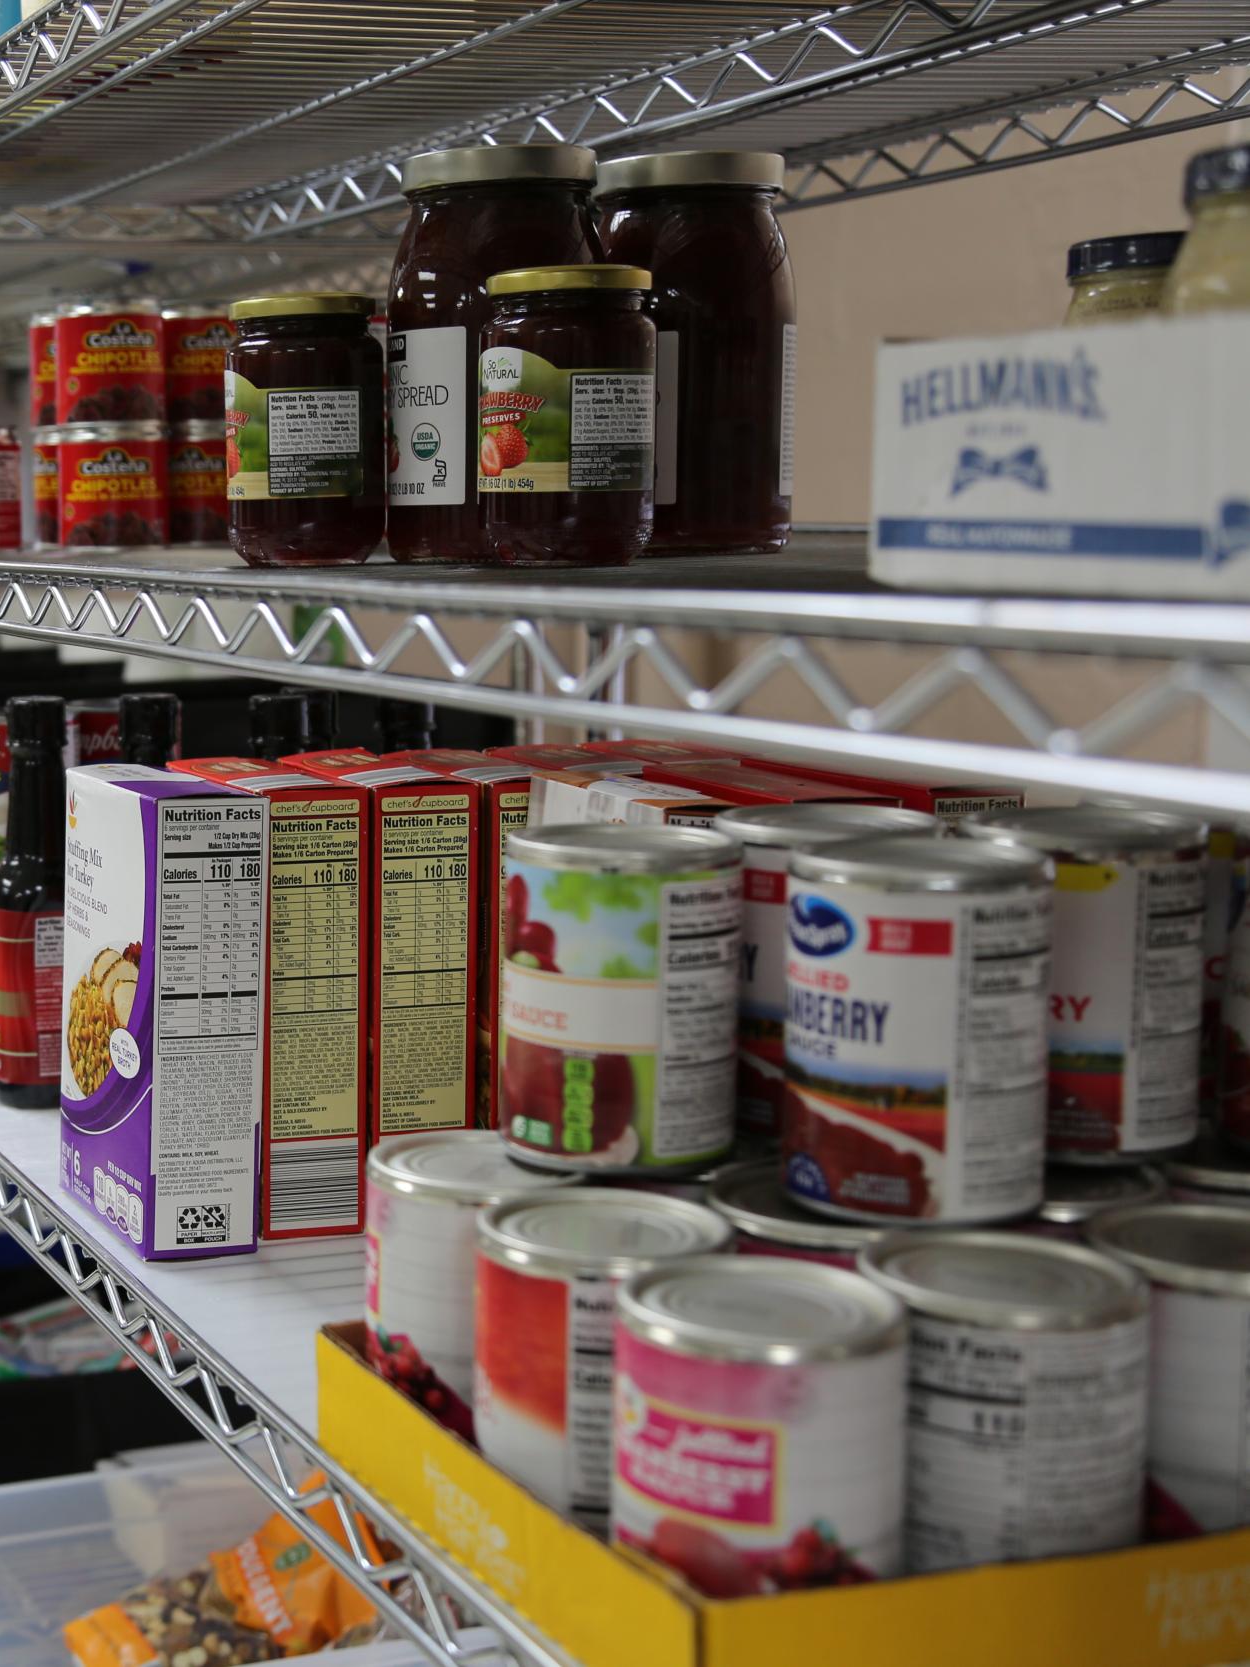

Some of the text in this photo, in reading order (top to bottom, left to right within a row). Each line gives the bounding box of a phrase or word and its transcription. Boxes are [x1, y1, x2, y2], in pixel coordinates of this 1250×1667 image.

[77, 351, 161, 365] CHIPOTLES
[173, 354, 224, 365] CHIPO
[484, 369, 519, 380] NATURAL
[575, 377, 622, 386] Nutrition Facts
[271, 394, 315, 403] Nutrition Facts
[398, 385, 449, 409] SPREAD
[482, 412, 521, 425] PRESERVES
[417, 432, 434, 441] USDA
[73, 478, 157, 493] CHIPOTLES
[416, 482, 425, 495] OZ
[494, 479, 500, 489] OZ
[518, 478, 535, 490] 454g
[276, 802, 354, 813] chef's cupboard
[387, 797, 464, 809] chef's cupboard
[937, 798, 1018, 813] Nutrition Facts
[165, 808, 261, 821] Nutrition Facts
[169, 824, 188, 832] servings
[199, 823, 220, 831] container
[272, 819, 357, 833] Nutrition Facts
[383, 815, 467, 828] Nutrition Facts
[164, 834, 181, 842] Serving
[222, 832, 231, 841] Cup
[240, 831, 248, 839] Mix
[277, 835, 298, 843] servings
[232, 841, 240, 849] Cup
[241, 841, 261, 849] Prepared
[272, 843, 295, 851] Serving
[437, 844, 464, 852] Prepared
[90, 847, 102, 868] Mix
[326, 849, 354, 857] Prepared
[163, 862, 261, 880] Calories 110 180
[272, 868, 357, 886] Calories 110 180
[383, 863, 467, 880] Calories 110 180
[75, 864, 94, 893] Turkey
[91, 898, 108, 915] BLEND
[512, 1004, 568, 1031] SAUCE
[118, 1056, 131, 1069] BROTH
[74, 1150, 81, 1176] 6
